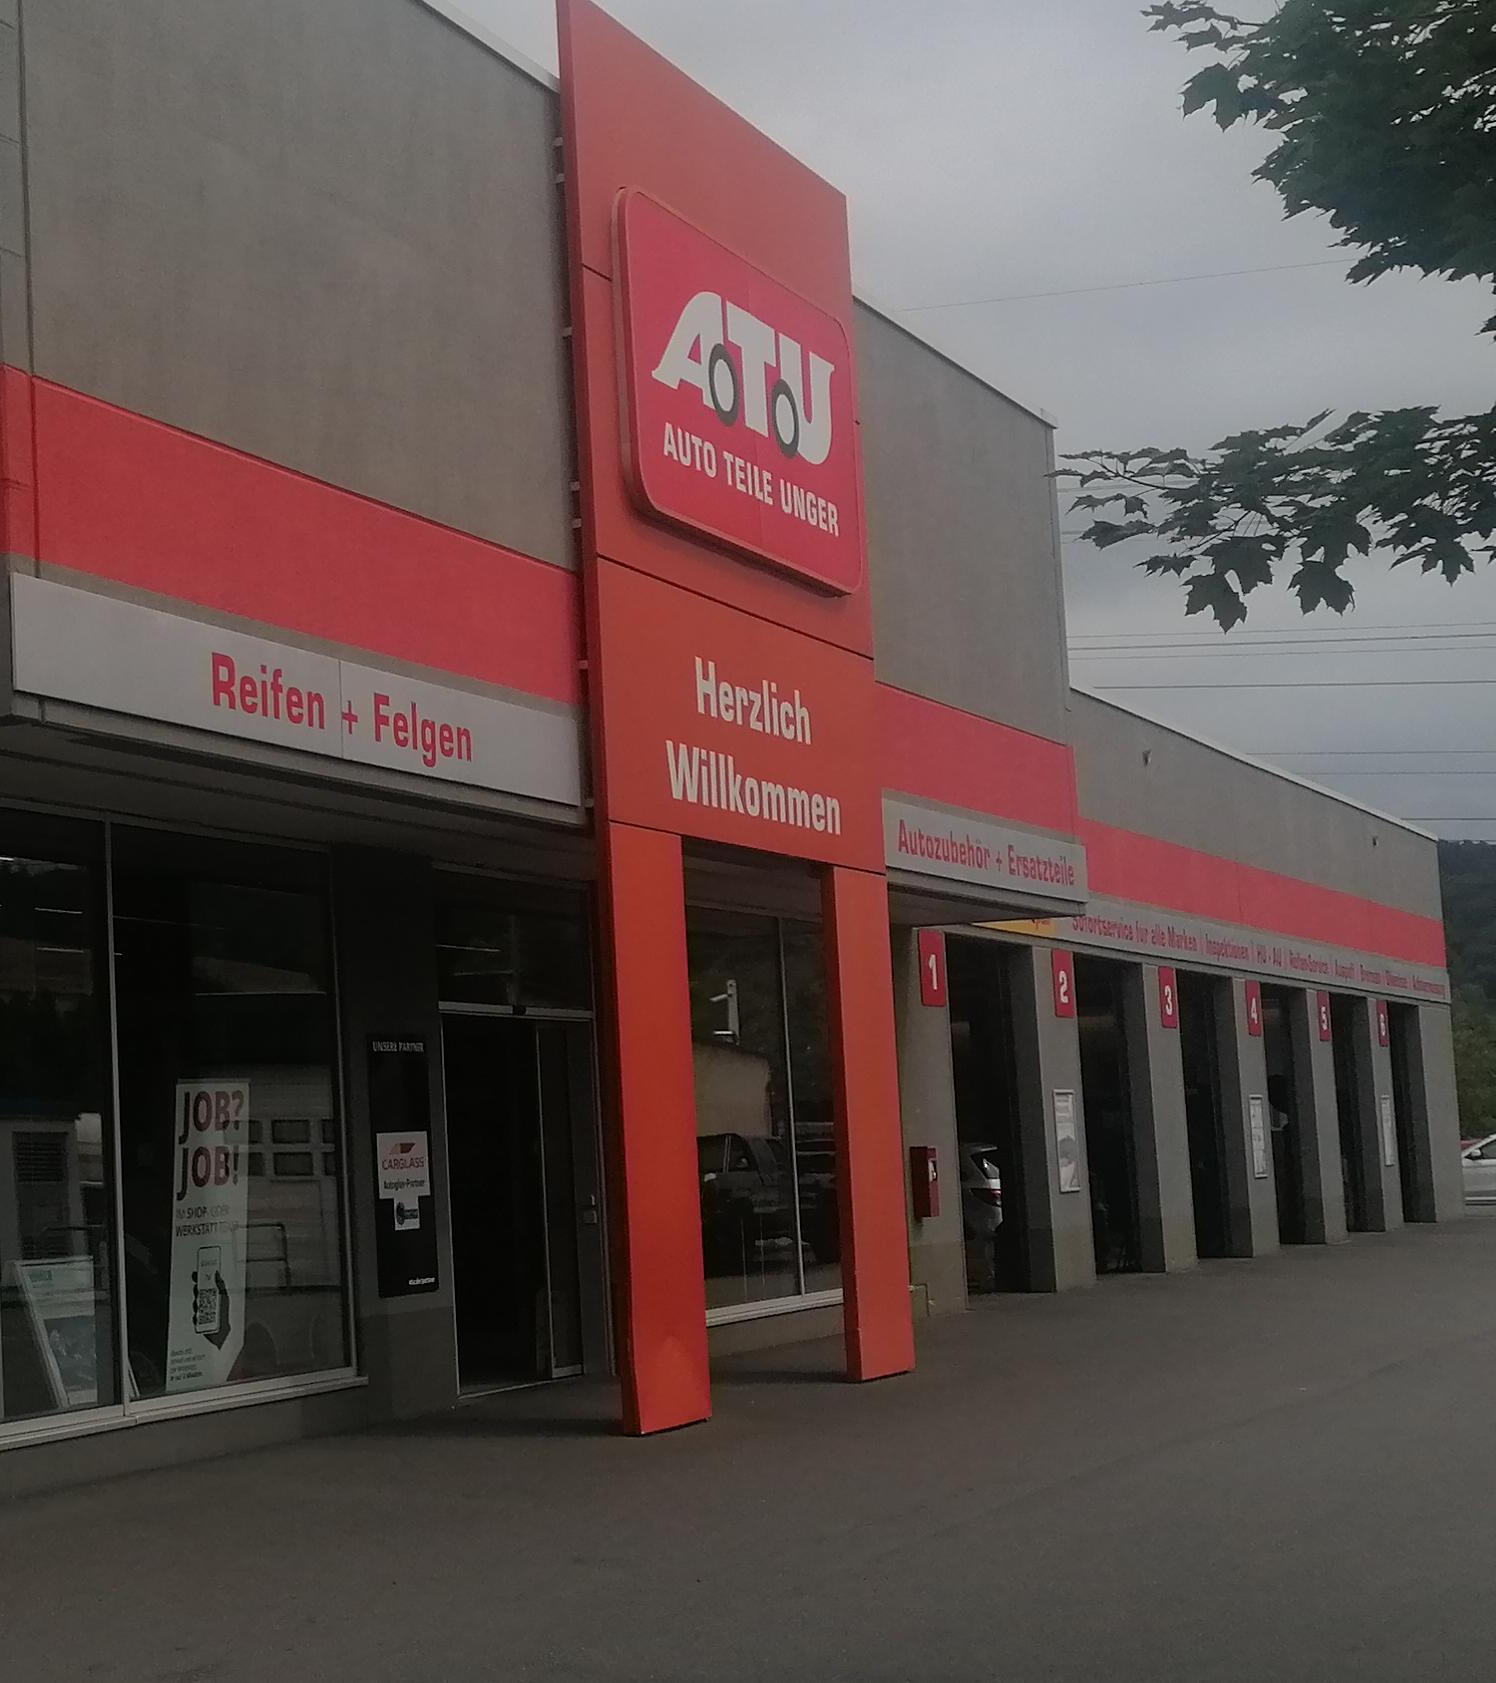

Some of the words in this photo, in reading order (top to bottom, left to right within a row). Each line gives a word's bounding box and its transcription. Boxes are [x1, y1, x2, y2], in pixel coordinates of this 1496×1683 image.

[651, 291, 836, 465] ATU
[663, 421, 718, 480] AUTO
[723, 451, 774, 506] TEILE
[780, 479, 840, 538] UNGER
[211, 651, 326, 730] Reifen
[373, 692, 473, 768] Felgen
[695, 656, 812, 745] Herzlich
[665, 739, 841, 835] Willkommen
[898, 819, 991, 871] Autozubehör
[1008, 844, 1075, 886] Ersatzteile
[929, 954, 938, 990] 1
[1059, 970, 1069, 1004] 2
[1164, 985, 1173, 1016] 3
[1250, 997, 1258, 1025] 4
[1320, 1006, 1328, 1032] 5
[178, 1090, 245, 1145] JOB?
[176, 1145, 239, 1201] JOB!
[382, 1157, 425, 1170] CARGLASS
